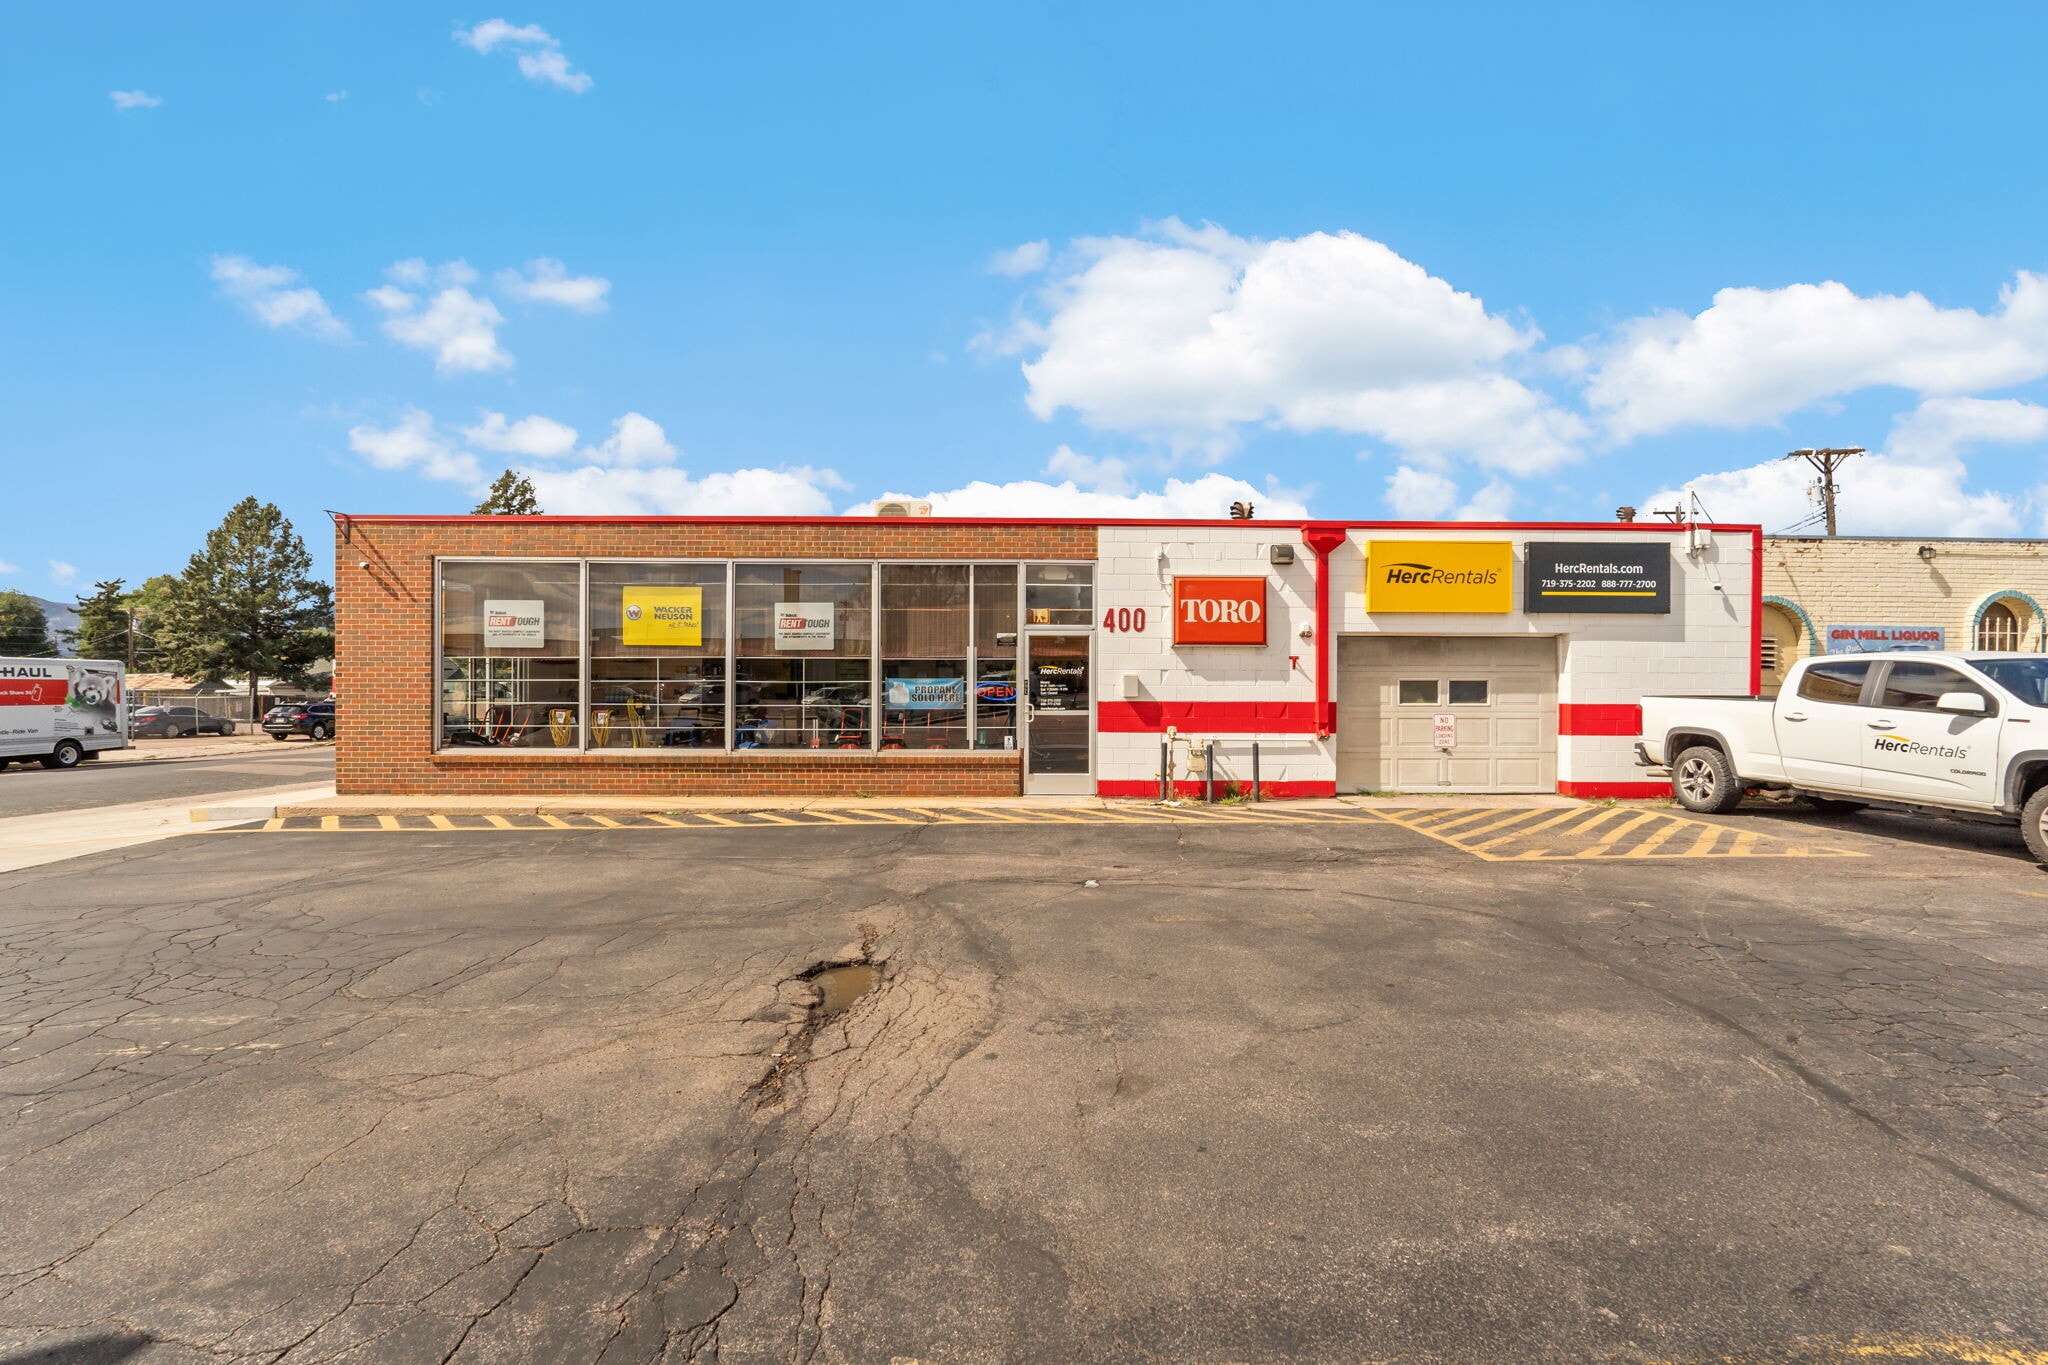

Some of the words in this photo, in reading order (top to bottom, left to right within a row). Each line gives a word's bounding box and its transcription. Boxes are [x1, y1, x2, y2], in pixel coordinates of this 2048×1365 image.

[1555, 563, 1643, 574] HercRentals.com
[1386, 568, 1498, 585] HercRentals
[1541, 580, 1596, 588] 719-375-2202
[1601, 580, 1657, 589] 888-777-2700
[1181, 599, 1261, 624] TORO
[489, 616, 513, 626] RENT
[780, 619, 803, 629] RENT
[1103, 607, 1147, 633] 400
[1831, 629, 1855, 640] GIN
[1858, 630, 1889, 640] MILL
[1892, 630, 1940, 641] LIQUOR
[915, 685, 957, 694] PROPANE
[976, 686, 1014, 698] OPEN
[911, 694, 935, 702] SOLD
[938, 694, 961, 702] HERE
[1874, 738, 1968, 759] HercRentals
